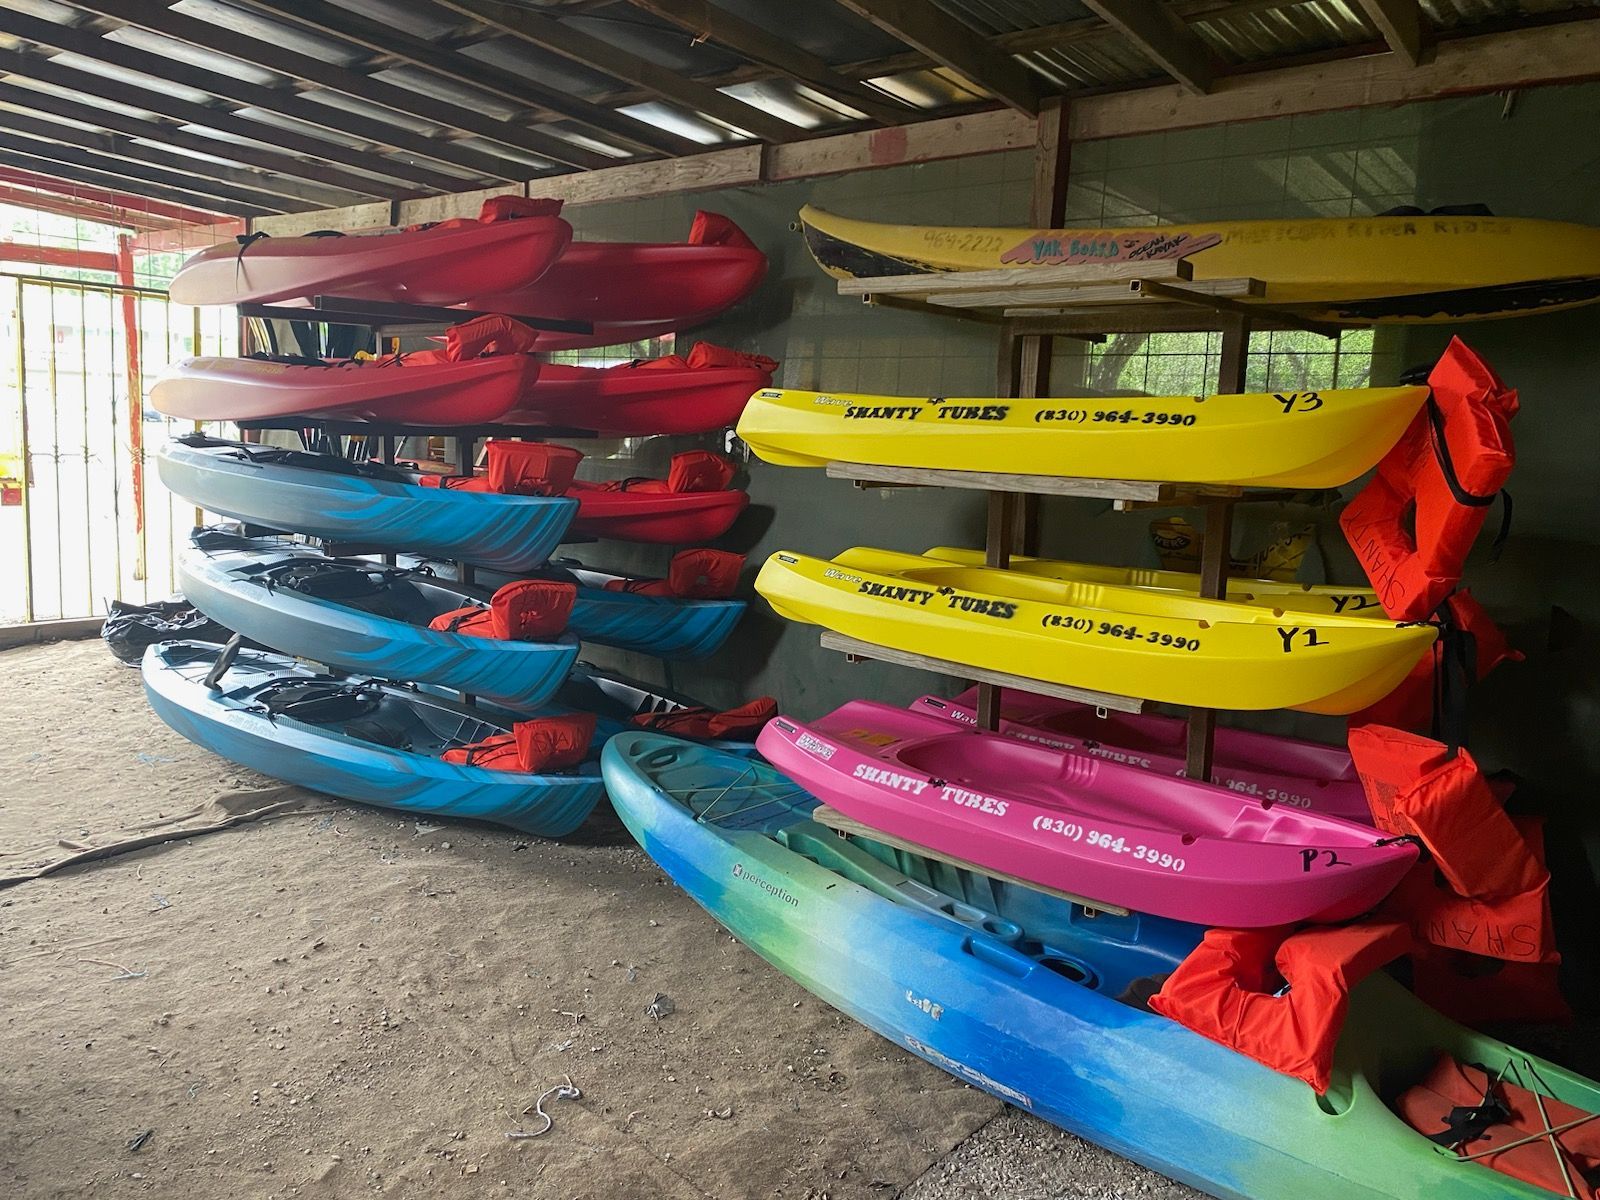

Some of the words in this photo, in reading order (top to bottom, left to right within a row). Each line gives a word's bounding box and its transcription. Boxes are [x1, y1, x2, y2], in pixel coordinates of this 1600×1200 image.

[1272, 391, 1323, 413] Y3
[843, 406, 923, 421] SHANTY
[937, 405, 1010, 421] TUBES
[1034, 409, 1087, 424] (830)
[1091, 410, 1197, 427] 964-3990
[823, 567, 863, 584] Wave
[1330, 595, 1381, 613] Y2
[858, 580, 934, 606] SHANTY
[947, 595, 1018, 619] TUBES
[1041, 613, 1095, 635] (830)
[1096, 621, 1201, 652] 964-3990
[1276, 627, 1330, 653] Y1
[952, 708, 979, 728] Wav
[853, 763, 929, 796] SHANTY
[940, 785, 1010, 817] TUBES
[1032, 815, 1084, 842] (830)
[1086, 830, 1186, 873] 964-3990
[1298, 848, 1353, 873] P2
[742, 871, 800, 908] perception
